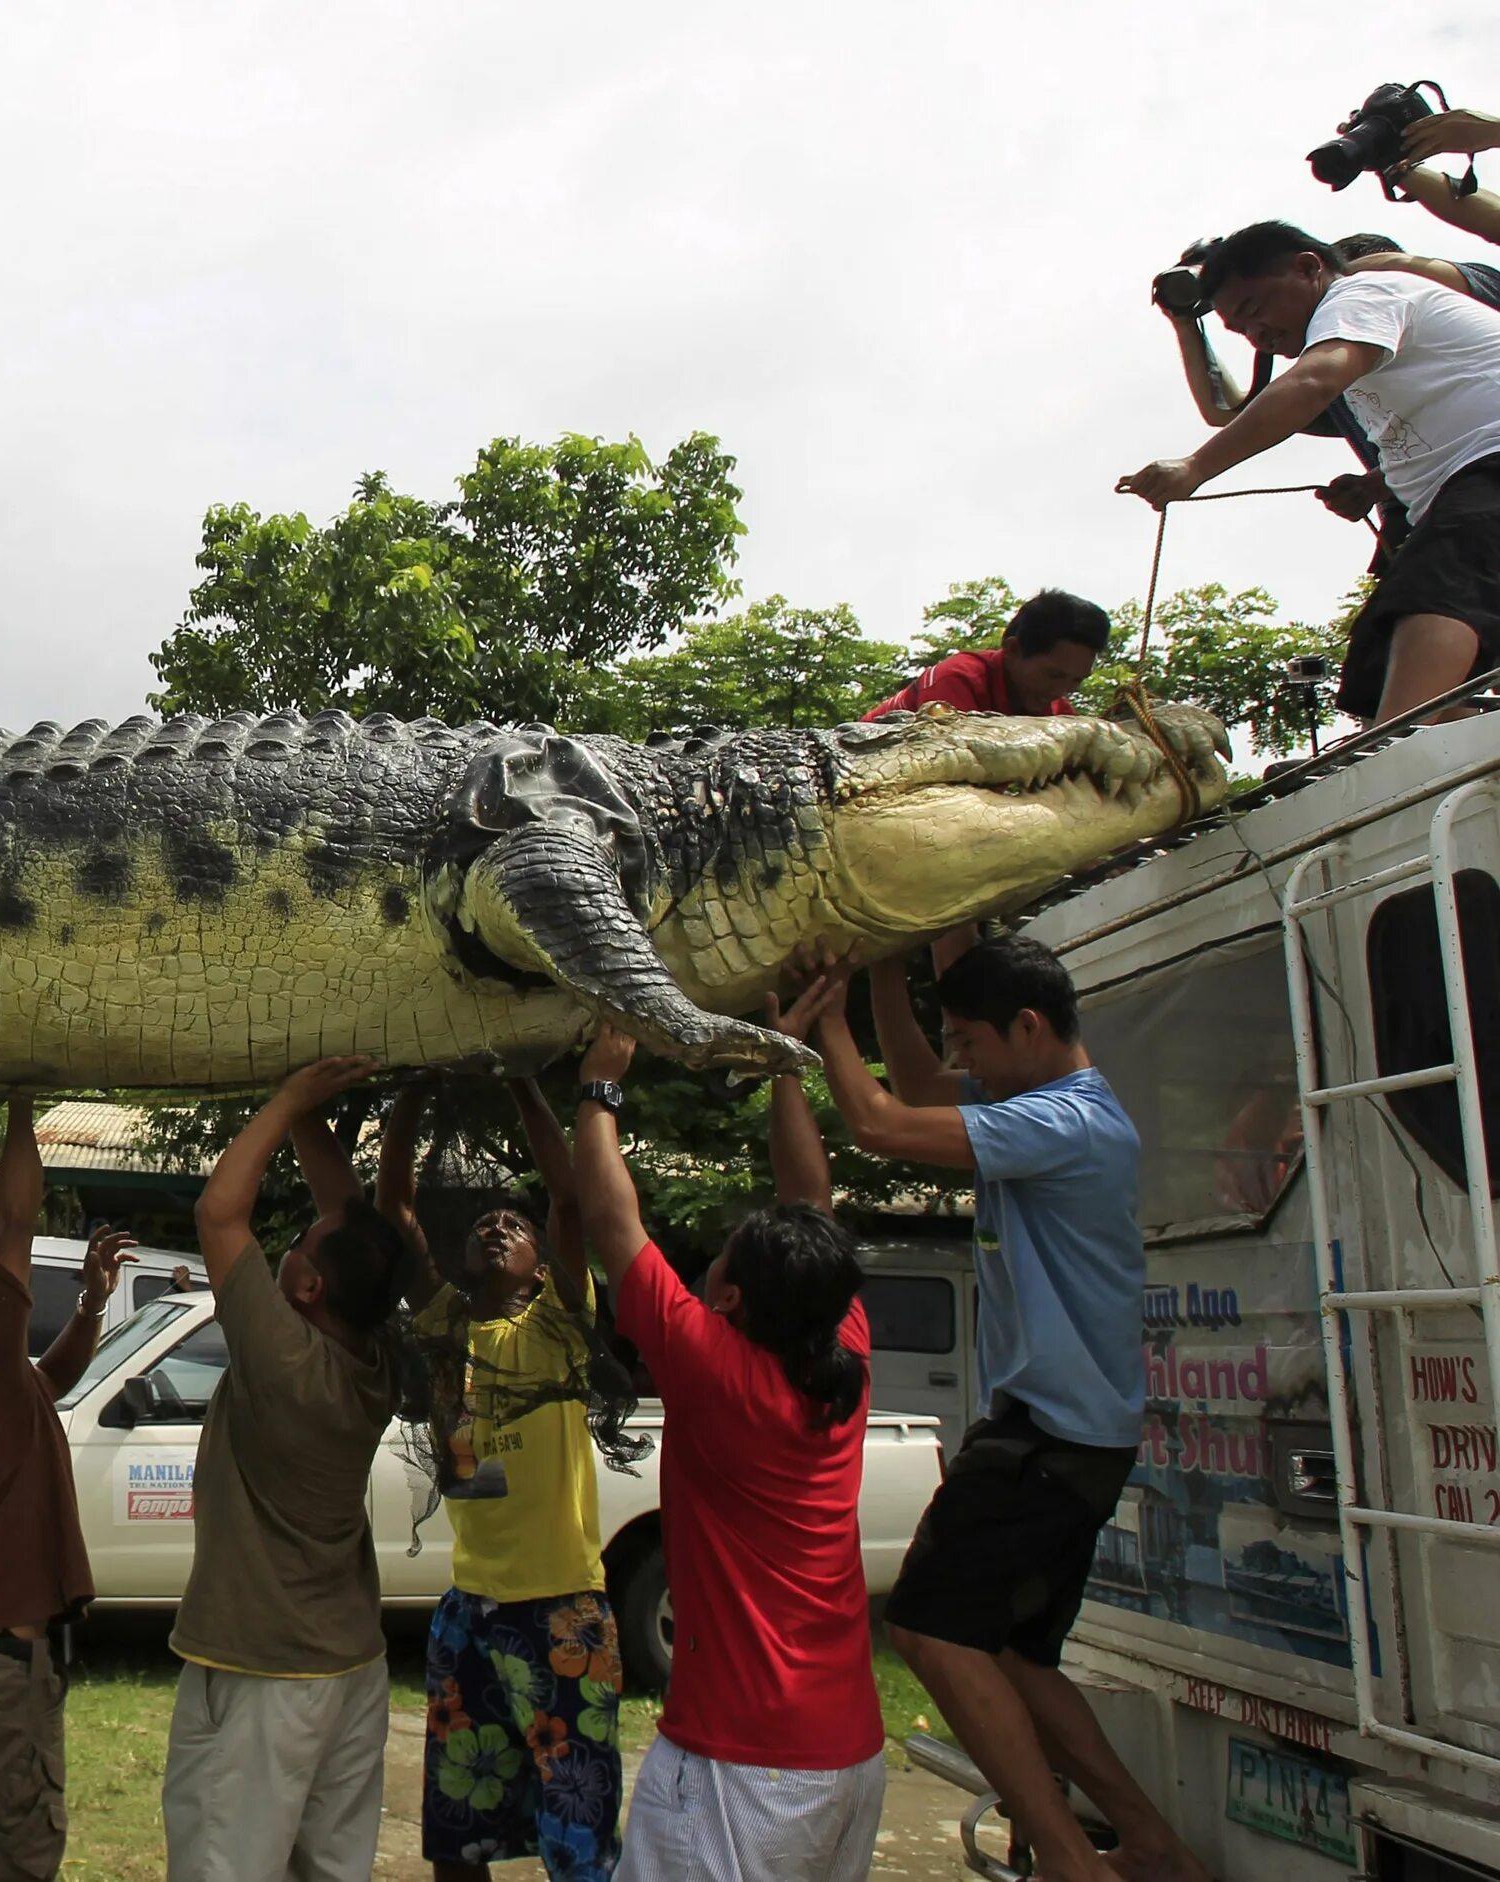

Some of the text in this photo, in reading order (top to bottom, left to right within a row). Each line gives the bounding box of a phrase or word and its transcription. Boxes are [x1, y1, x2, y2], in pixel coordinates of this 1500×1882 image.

[1186, 1282, 1242, 1332] Apo
[1410, 1355, 1478, 1404] HOW'S
[128, 1464, 194, 1481] MANILA
[130, 1494, 193, 1517] Tempo
[1187, 1677, 1332, 1756] KEEP DISTANCE
